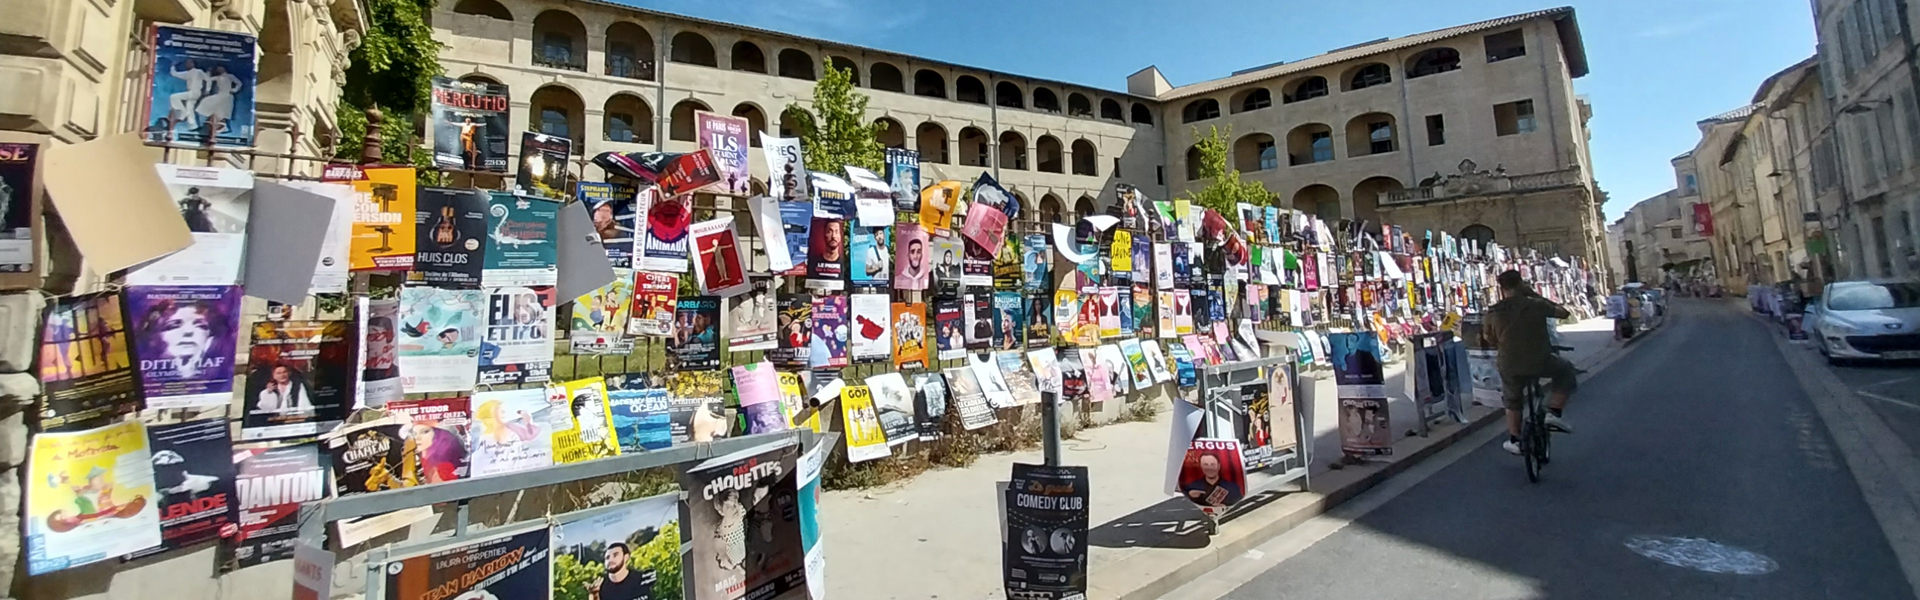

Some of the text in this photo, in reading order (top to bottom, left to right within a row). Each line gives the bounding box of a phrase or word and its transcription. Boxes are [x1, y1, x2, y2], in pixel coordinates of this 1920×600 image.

[712, 133, 738, 152] ILS
[354, 213, 402, 224] ERSION
[646, 231, 687, 253] ANIMAUX
[417, 251, 468, 264] HUIS CLOS
[420, 404, 449, 414] TUDOR
[1187, 441, 1236, 450] ERGUS
[562, 447, 587, 463] HOME
[703, 460, 783, 501] CHOUETTES
[732, 466, 749, 477] PAS
[235, 469, 325, 511] DANTON
[158, 492, 227, 521] LENDE
[1017, 493, 1083, 510] COMEDY CLUB
[436, 546, 508, 570] LAURA CHARPENTIER
[714, 574, 738, 593] MAIS
